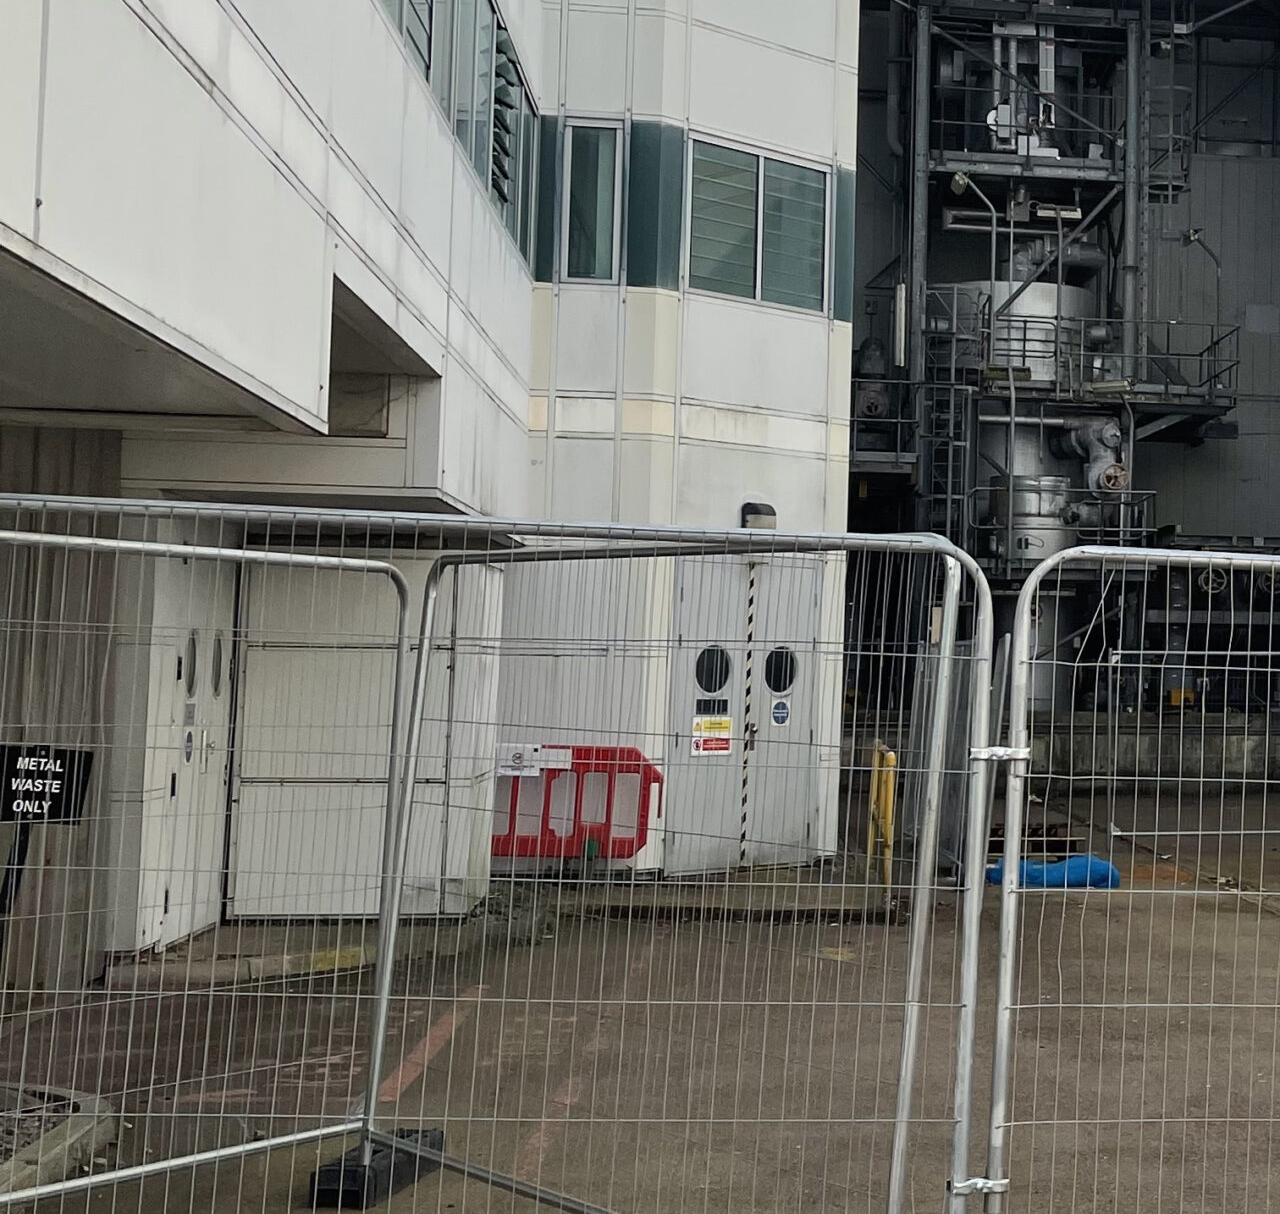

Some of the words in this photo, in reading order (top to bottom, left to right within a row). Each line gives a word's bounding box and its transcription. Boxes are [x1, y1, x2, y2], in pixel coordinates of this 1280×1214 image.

[16, 756, 64, 772] METAL
[11, 777, 62, 793] WASTE
[12, 799, 52, 813] ONLY
